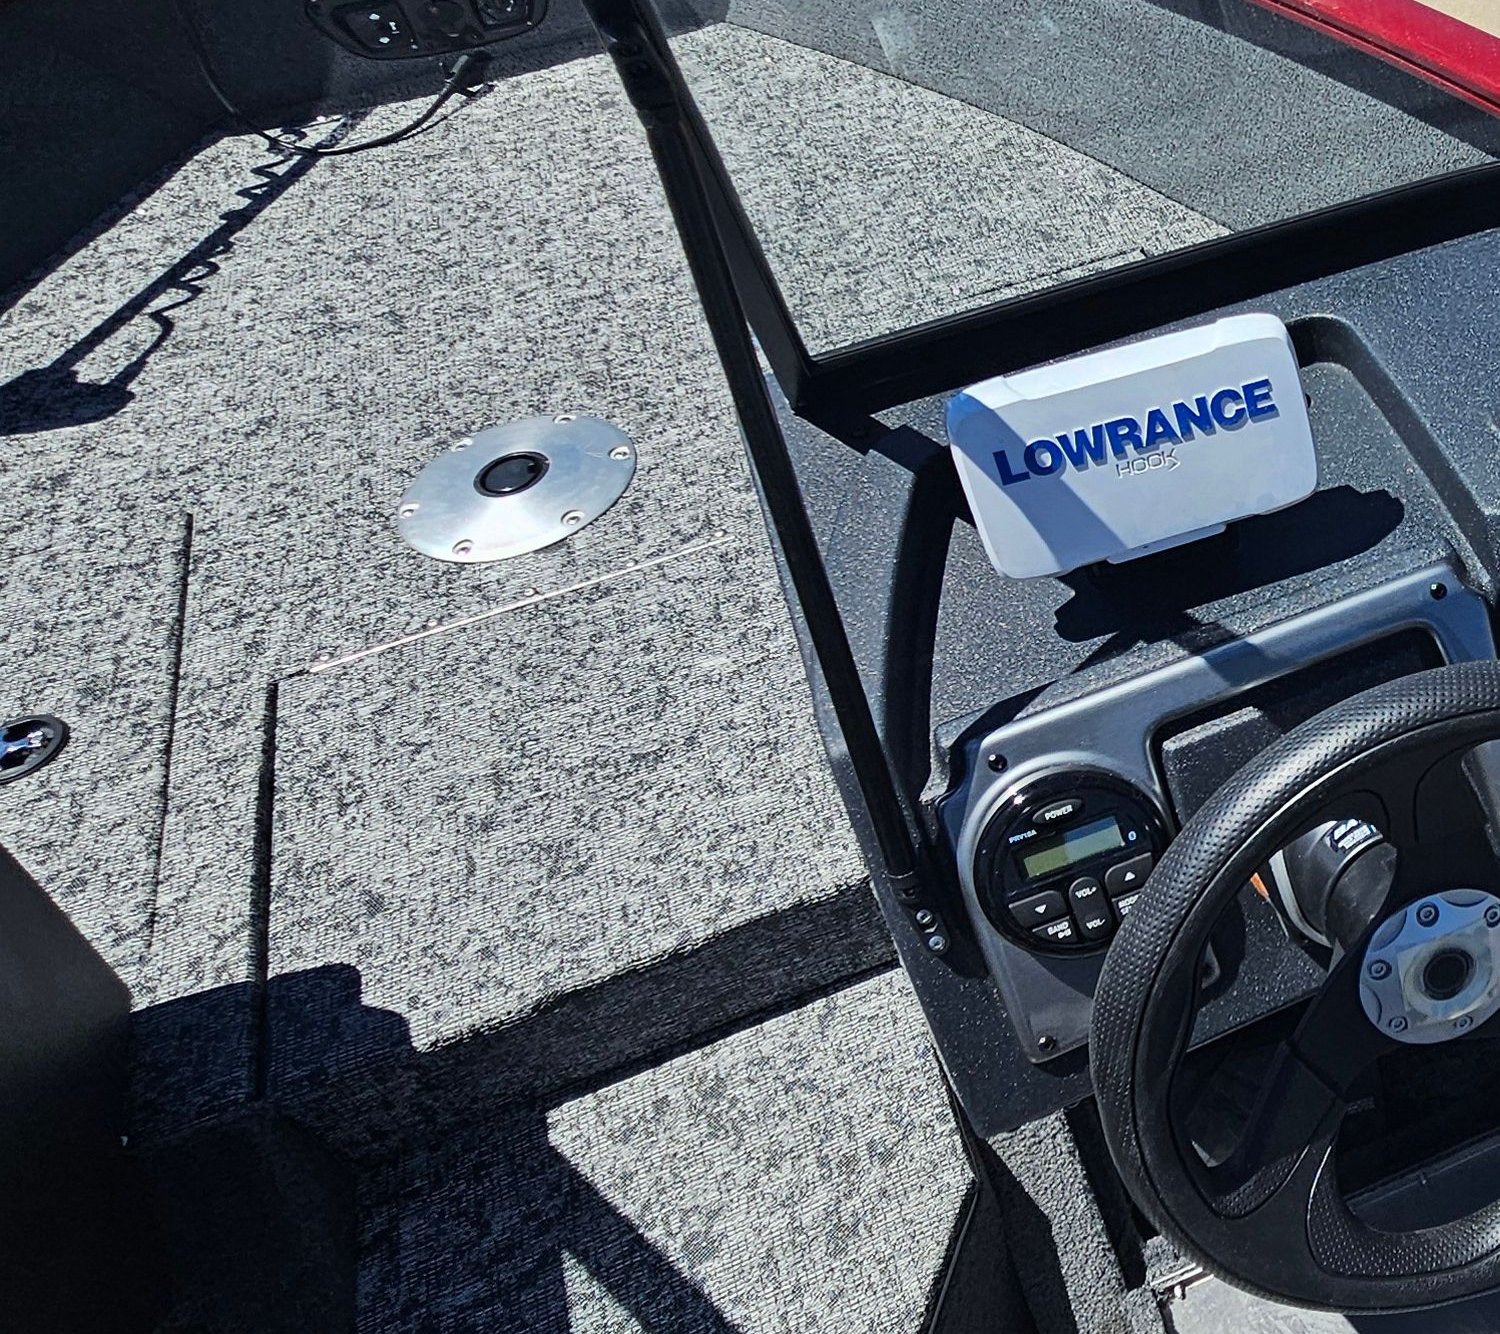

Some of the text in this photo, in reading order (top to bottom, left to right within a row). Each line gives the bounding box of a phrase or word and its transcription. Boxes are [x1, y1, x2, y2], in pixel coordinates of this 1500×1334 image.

[992, 378, 1279, 486] LOWRANCE
[1044, 804, 1073, 820] POWER
[1047, 921, 1069, 935] BAND
